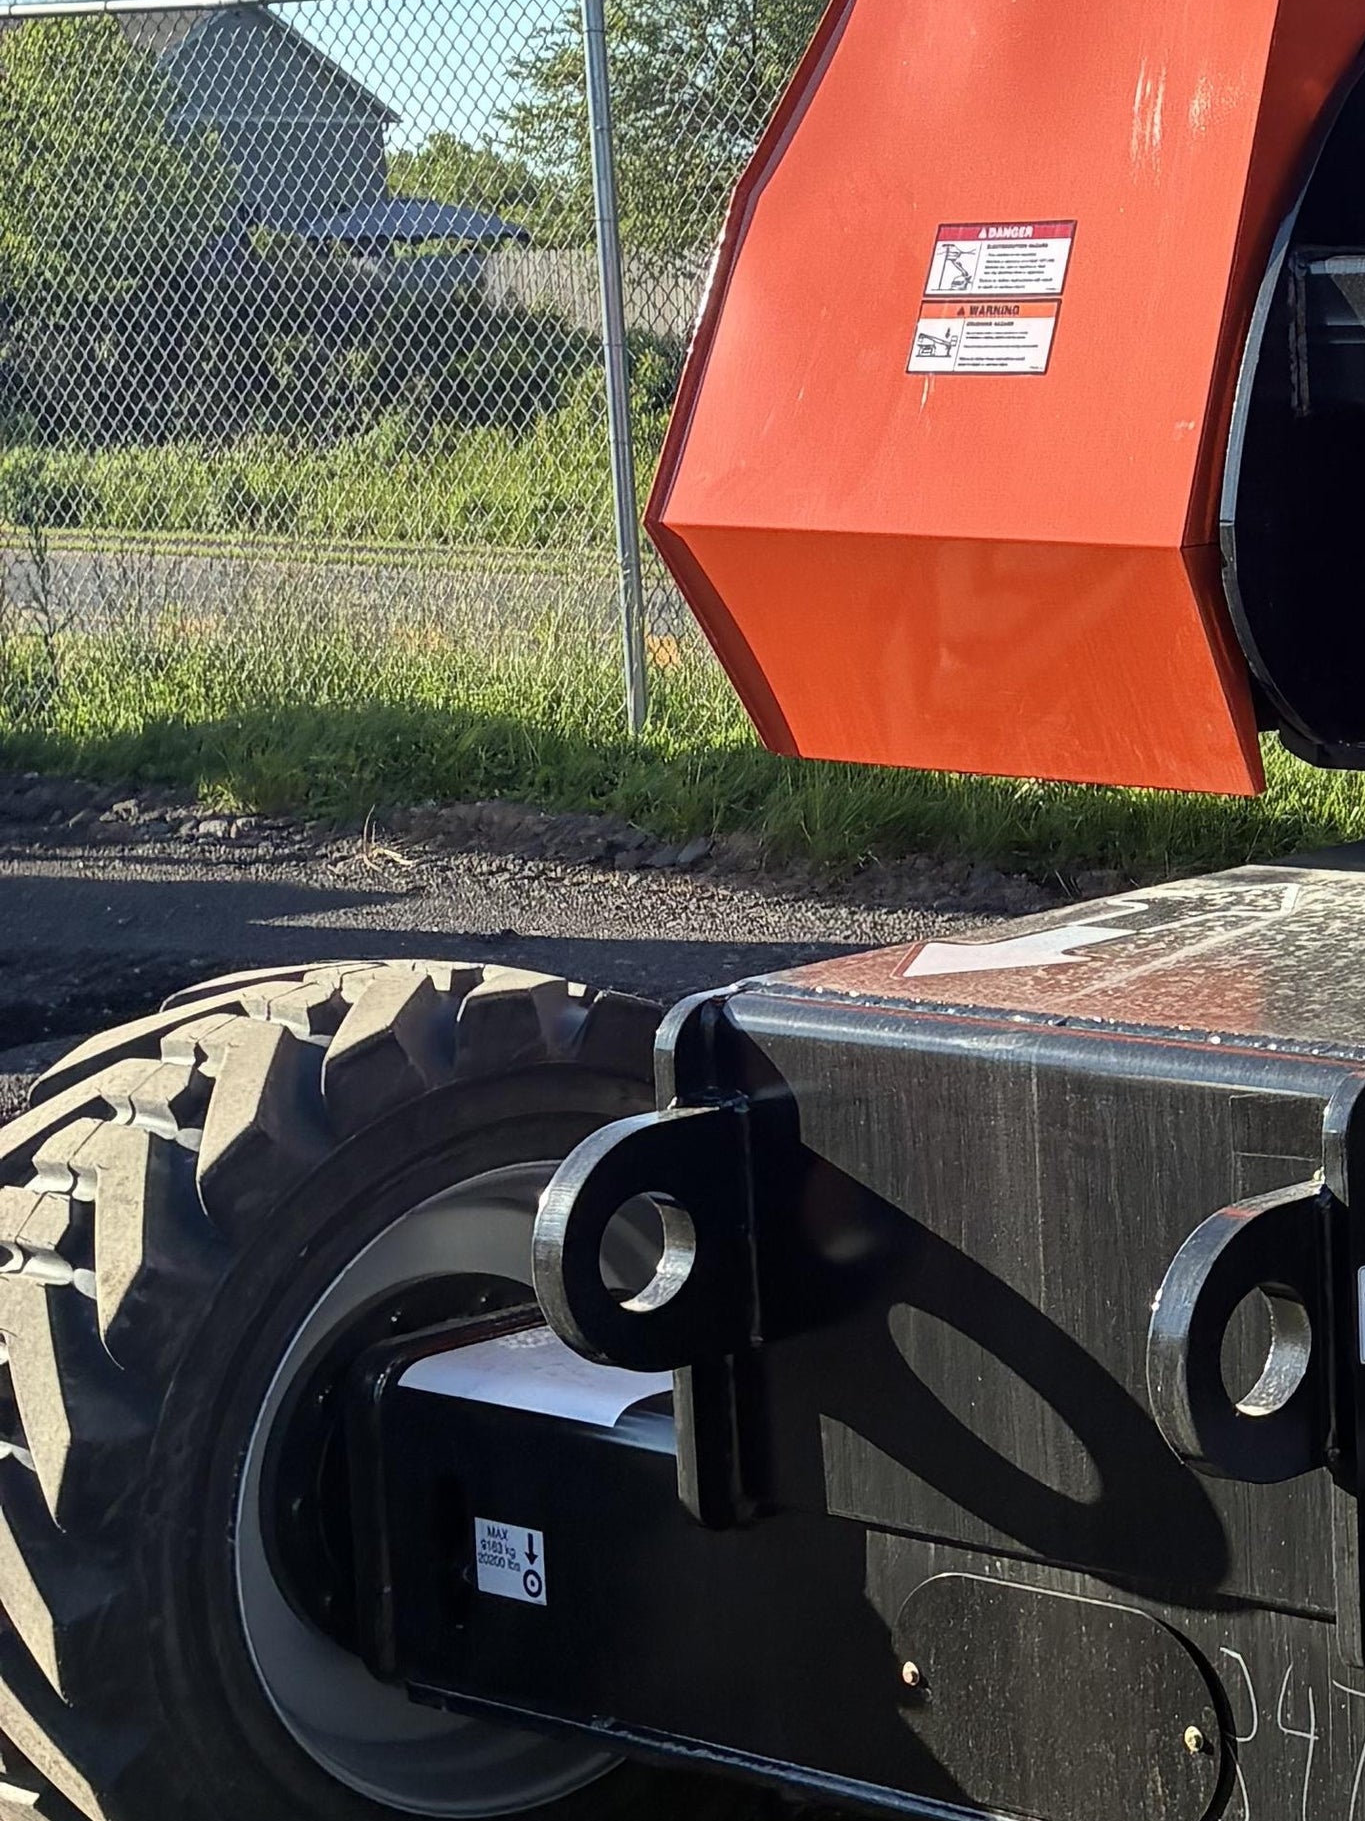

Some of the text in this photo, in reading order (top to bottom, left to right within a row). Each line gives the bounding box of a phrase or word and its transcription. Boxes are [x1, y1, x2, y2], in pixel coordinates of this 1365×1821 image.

[987, 226, 1033, 239] DANGER
[969, 305, 1020, 316] WARNING
[487, 1525, 508, 1540] MAX
